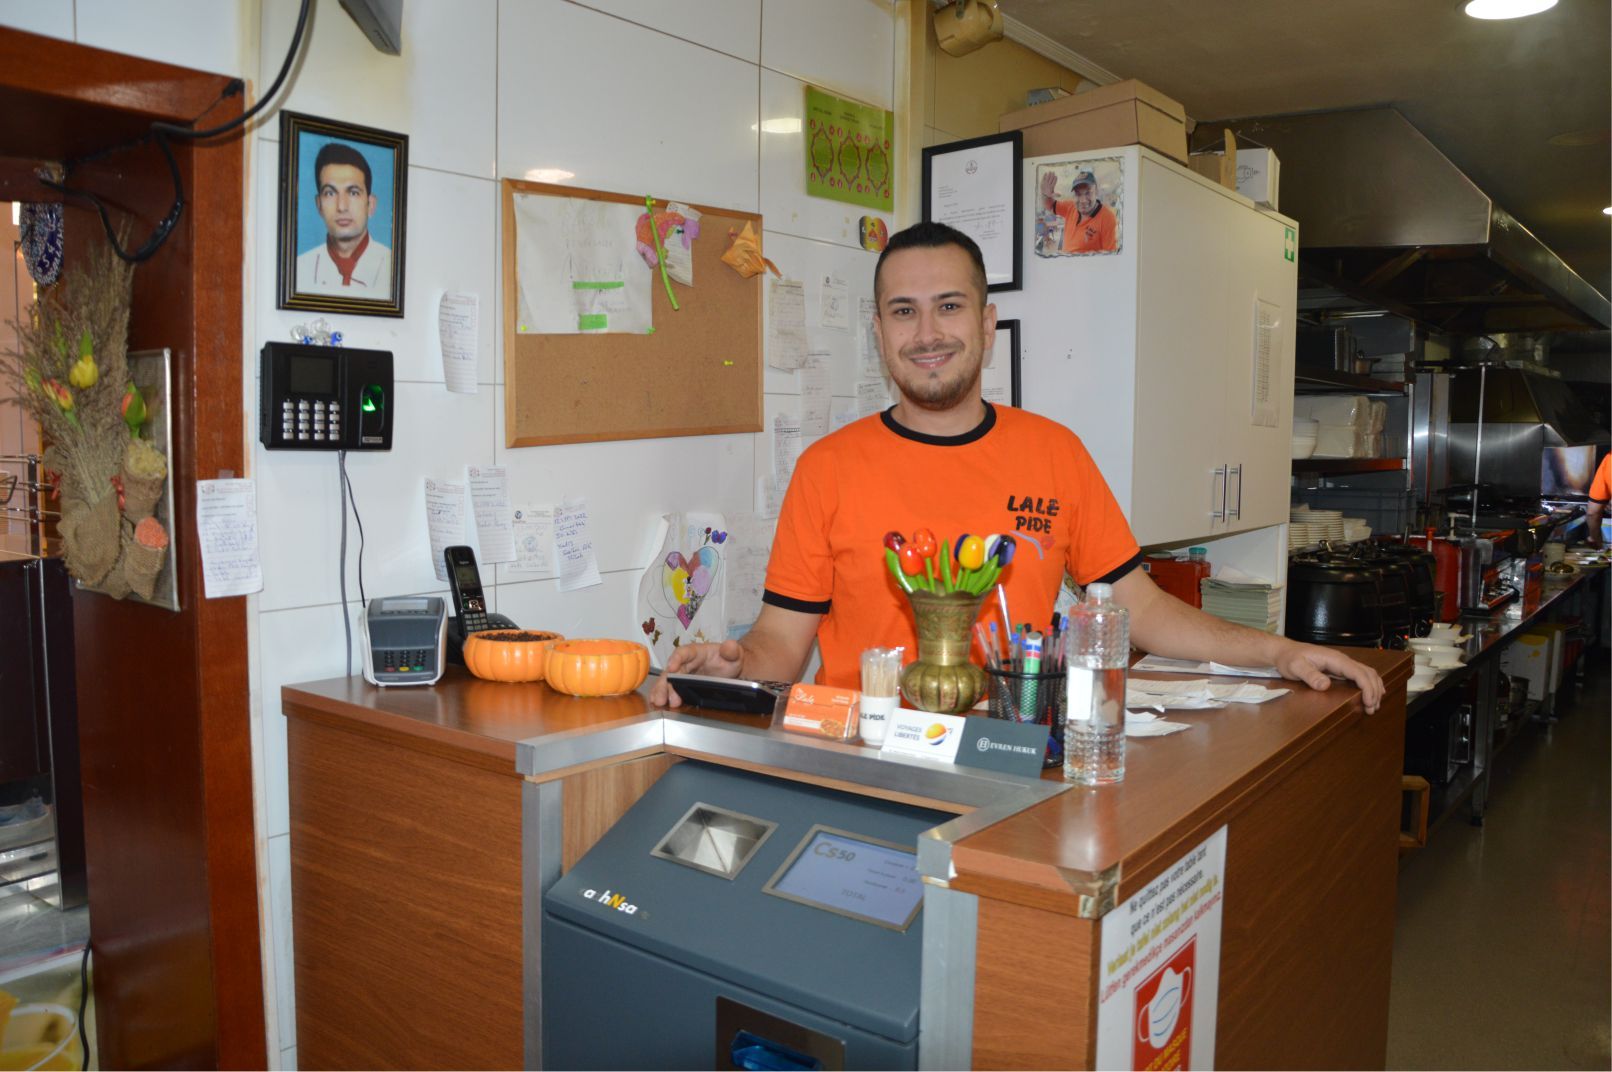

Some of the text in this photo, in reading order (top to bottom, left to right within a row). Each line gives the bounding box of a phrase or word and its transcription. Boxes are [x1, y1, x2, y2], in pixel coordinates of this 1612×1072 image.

[1007, 495, 1060, 517] LALE
[1015, 515, 1052, 535] PIDE
[897, 723, 922, 733] VOYAGES
